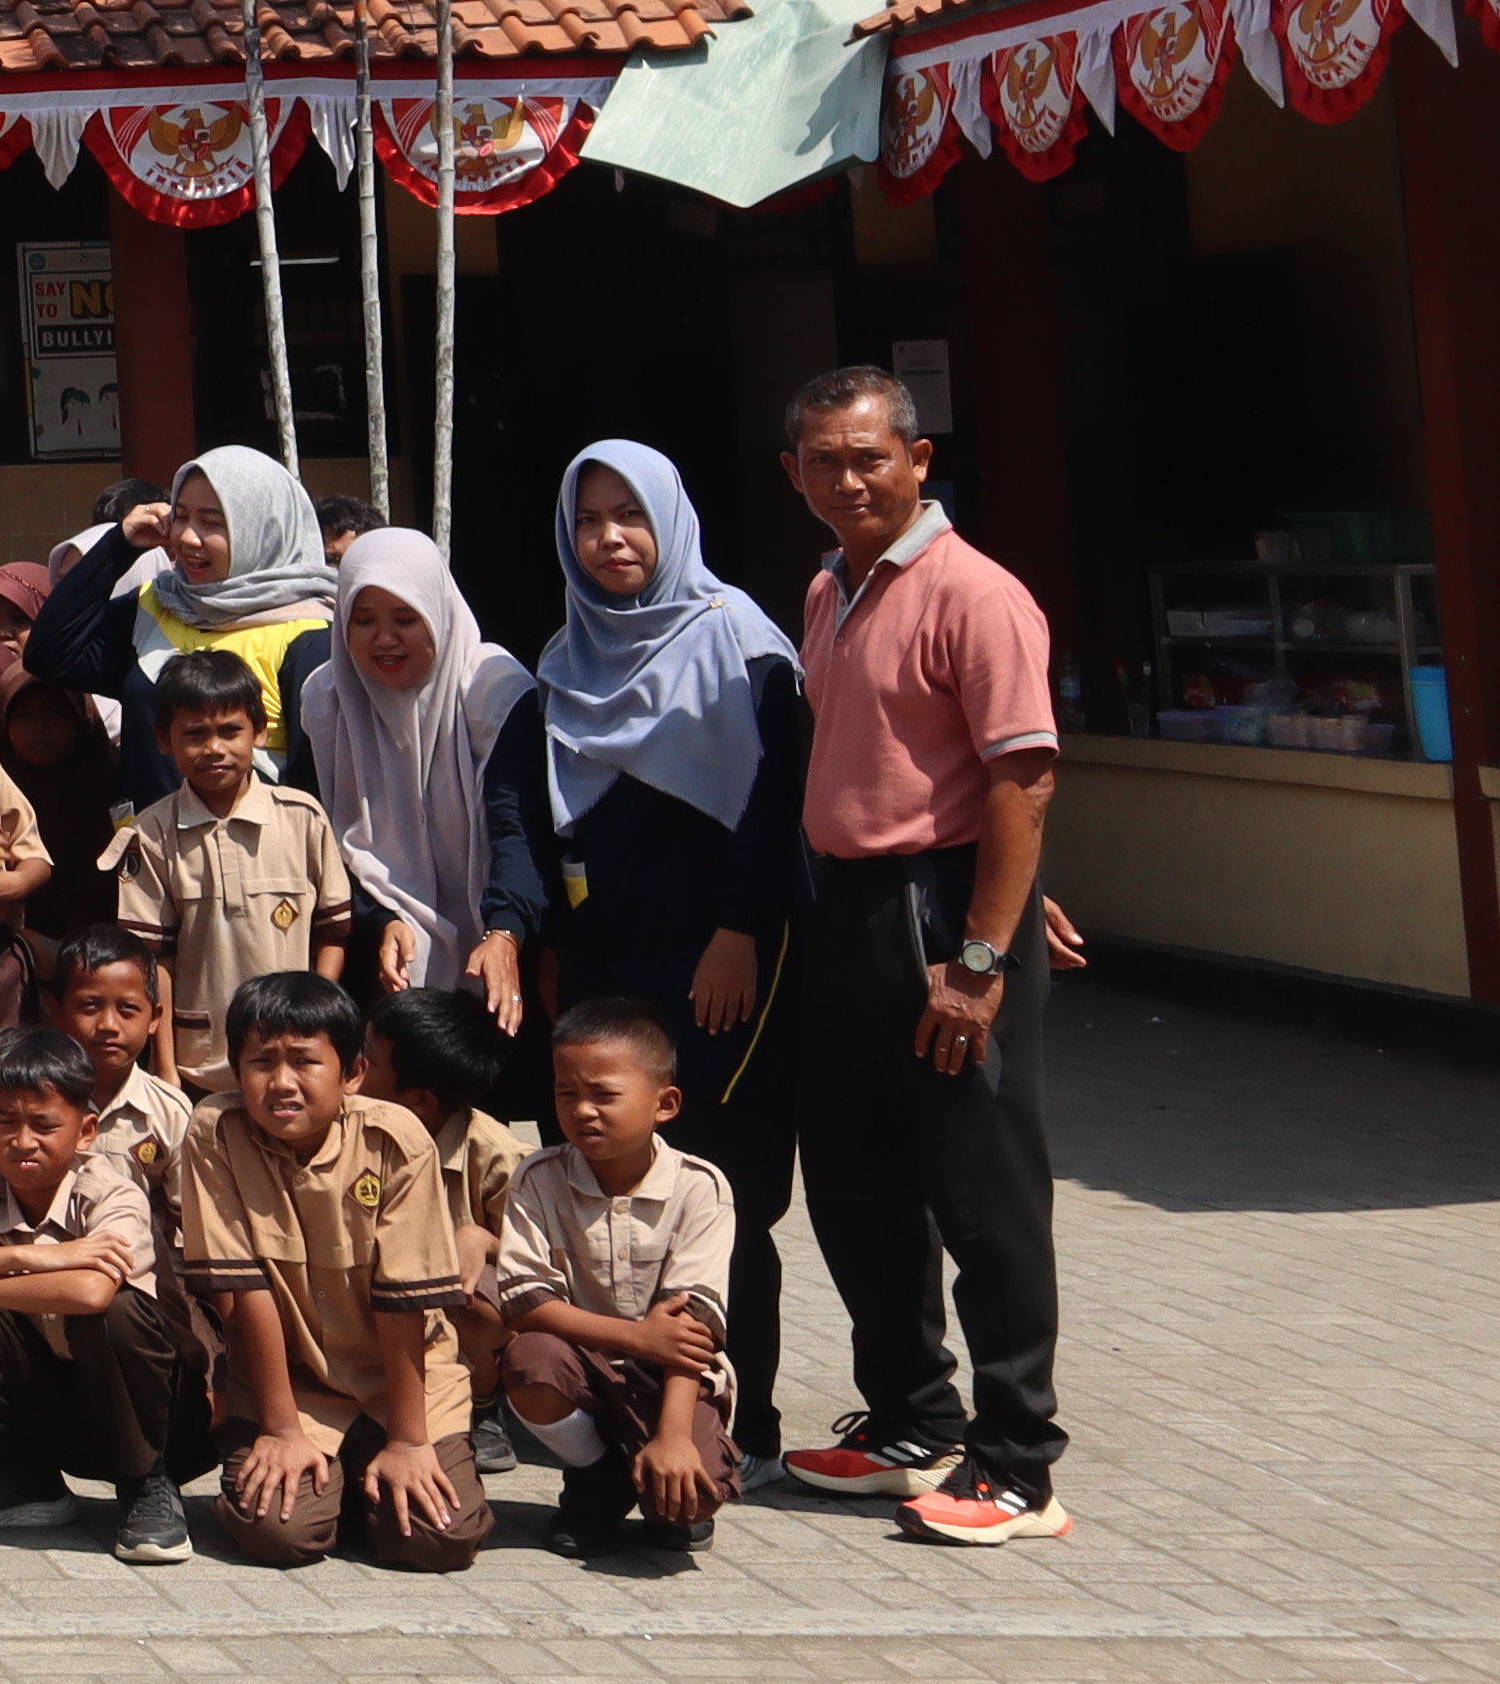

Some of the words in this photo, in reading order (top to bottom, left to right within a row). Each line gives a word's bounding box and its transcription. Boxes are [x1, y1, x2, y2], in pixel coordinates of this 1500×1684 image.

[35, 281, 67, 297] SAY
[36, 303, 58, 318] TO
[42, 329, 112, 347] BULLYI
